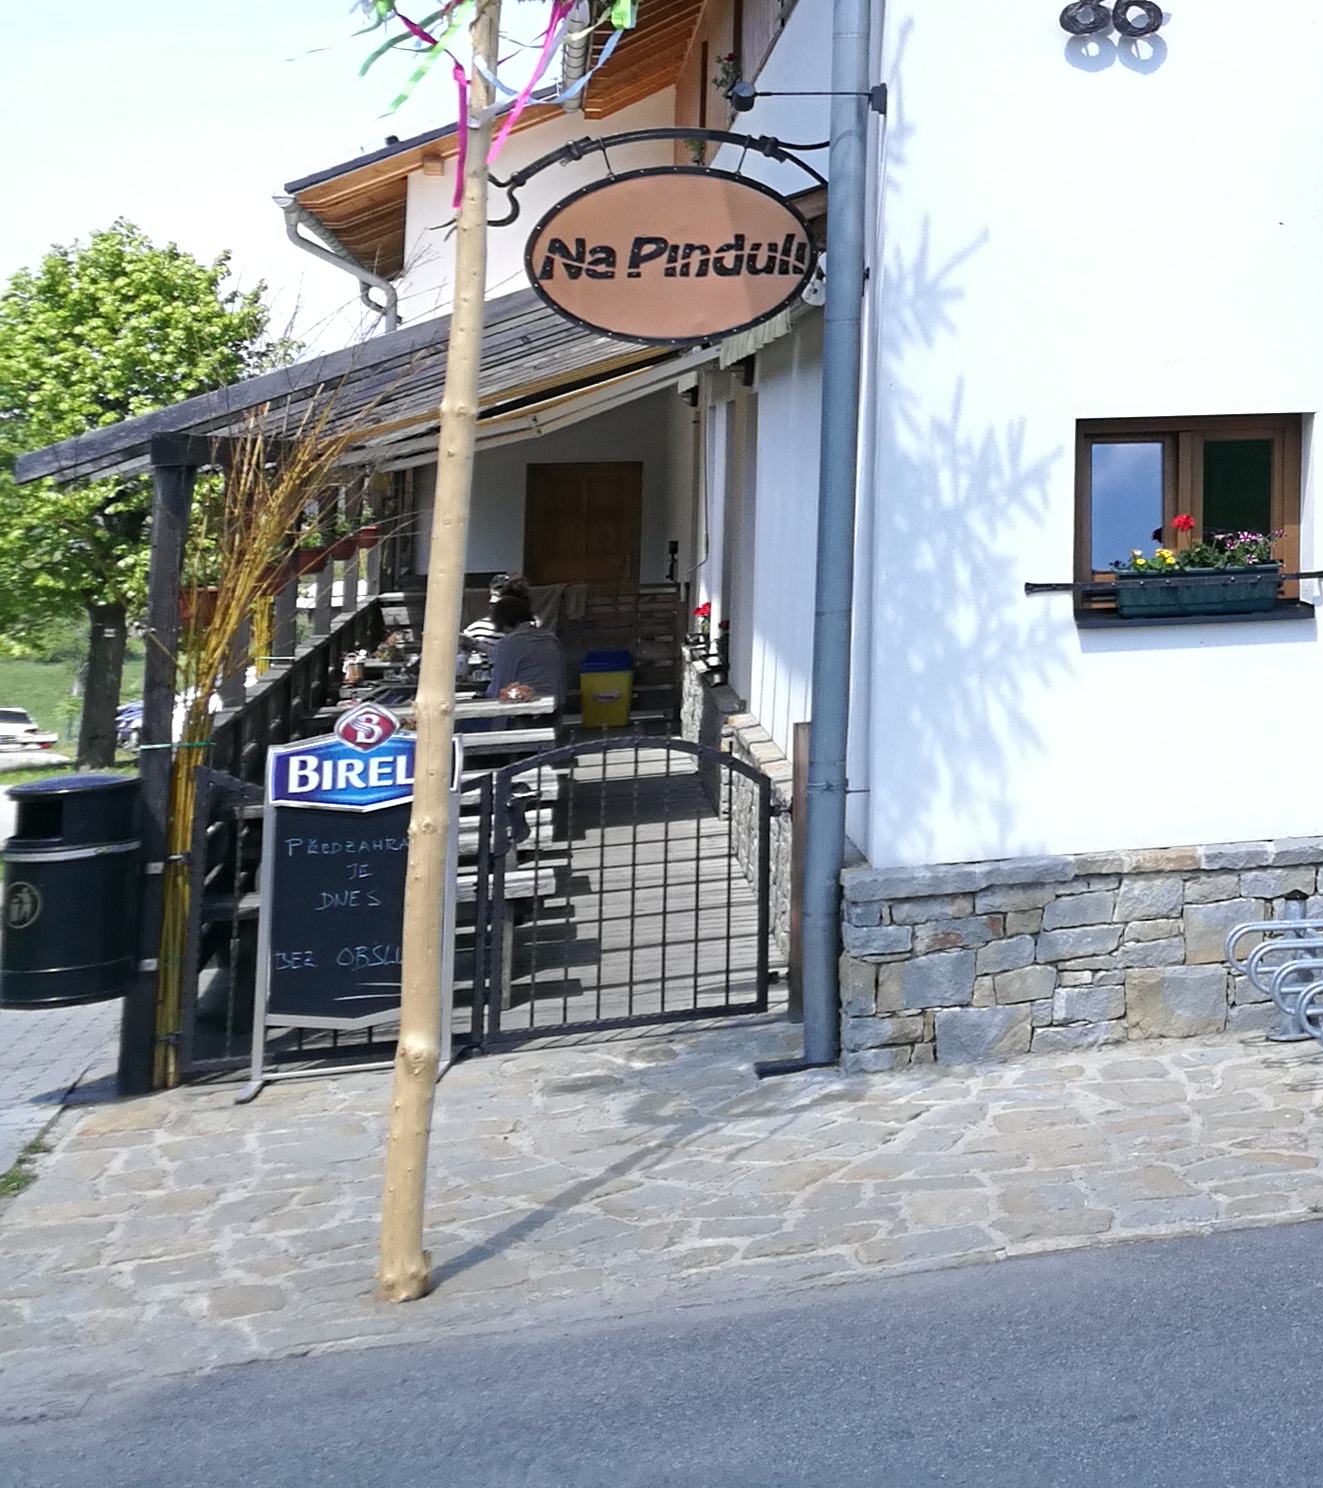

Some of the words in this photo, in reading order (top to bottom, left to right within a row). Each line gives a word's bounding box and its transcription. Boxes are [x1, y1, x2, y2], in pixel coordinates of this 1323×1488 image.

[538, 237, 617, 281] Na
[288, 755, 416, 794] BIREL
[346, 863, 374, 880] JE
[314, 890, 382, 911] DNES
[274, 950, 319, 971] BEZ
